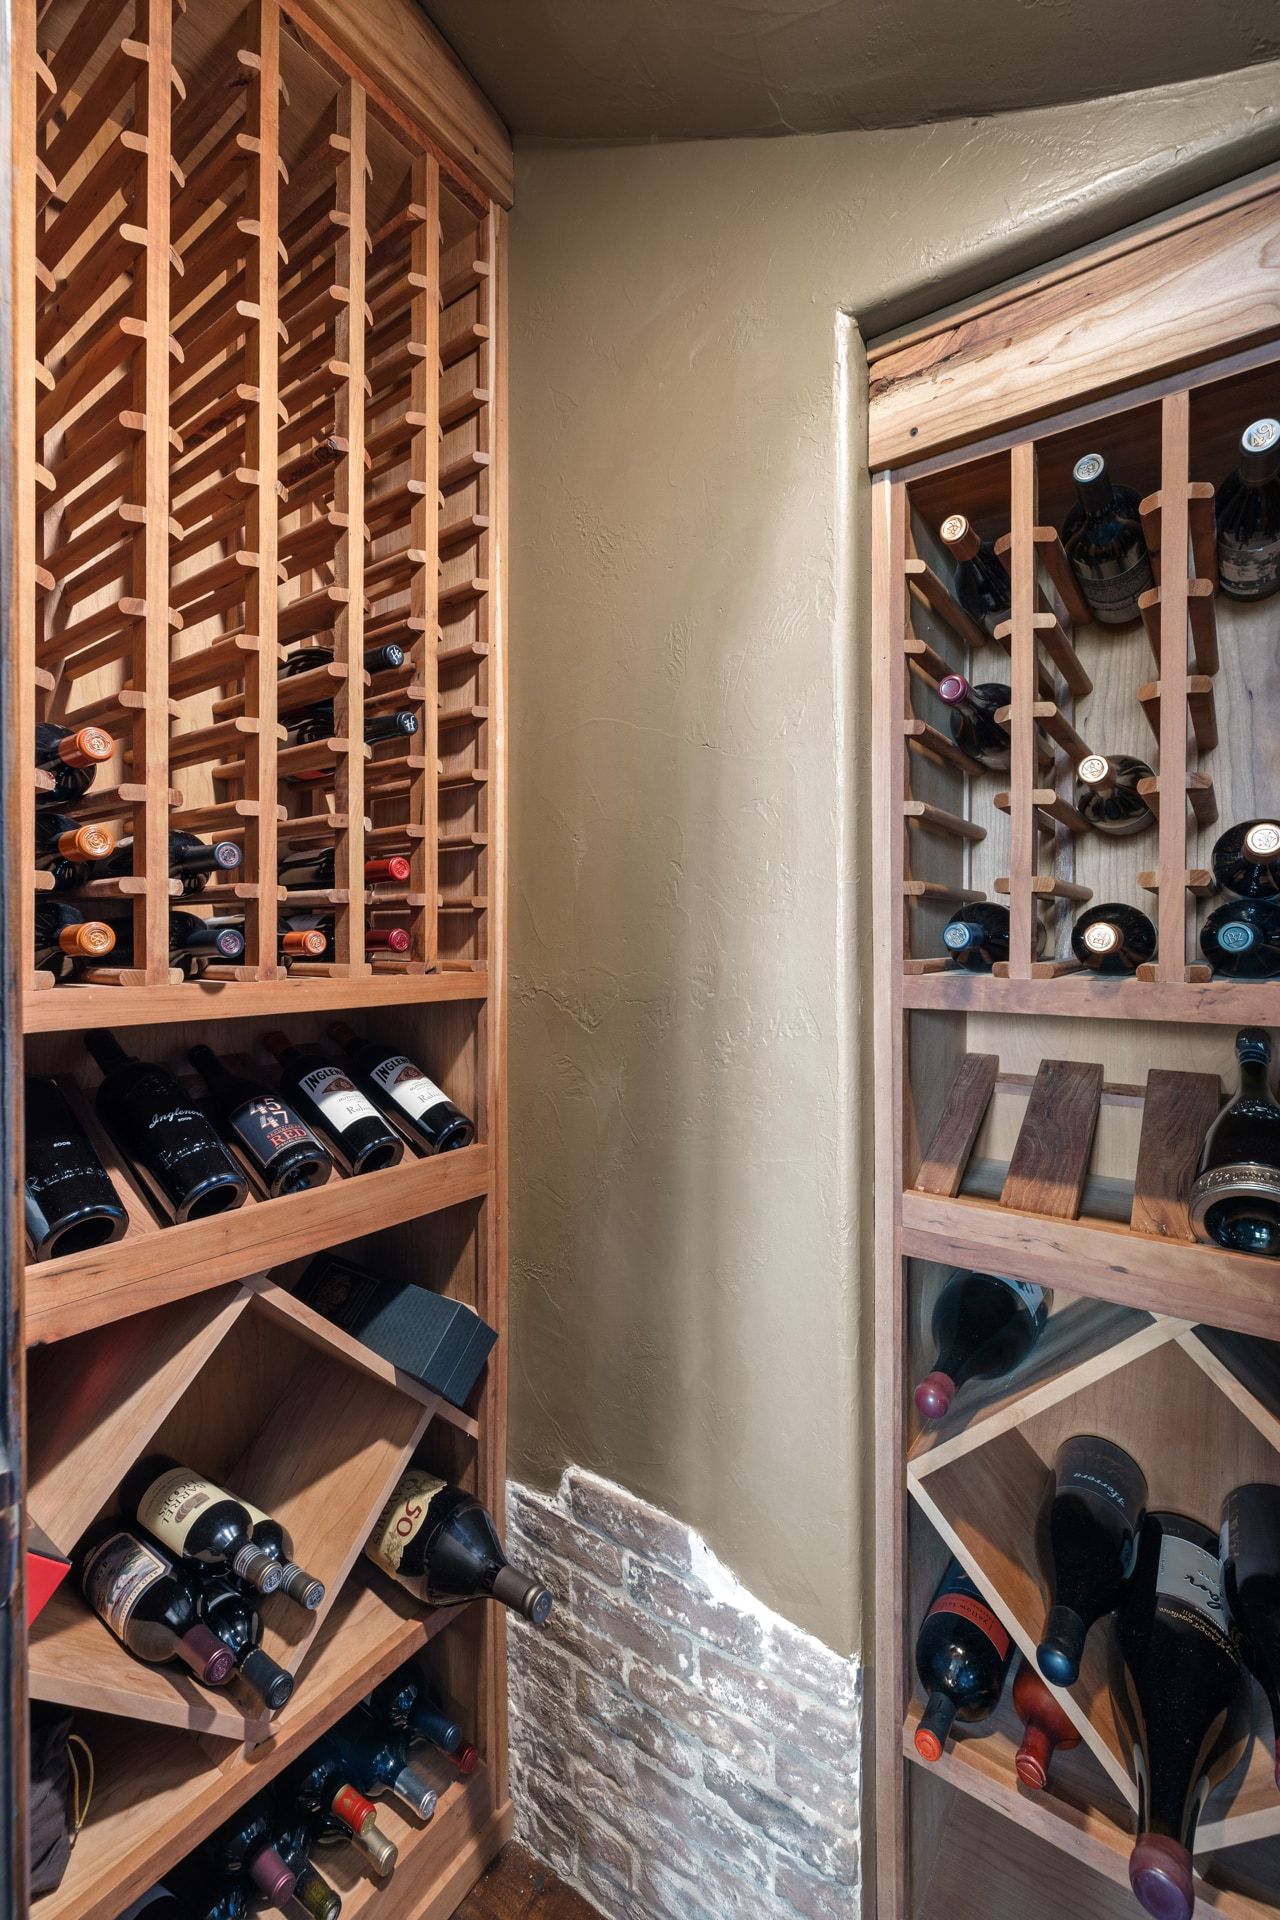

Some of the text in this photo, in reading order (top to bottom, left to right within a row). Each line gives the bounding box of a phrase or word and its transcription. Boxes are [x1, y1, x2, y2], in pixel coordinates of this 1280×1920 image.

[249, 1098, 281, 1115] 45
[260, 1110, 289, 1128] 47
[270, 1128, 307, 1148] RED
[161, 1484, 206, 1525] BARREL
